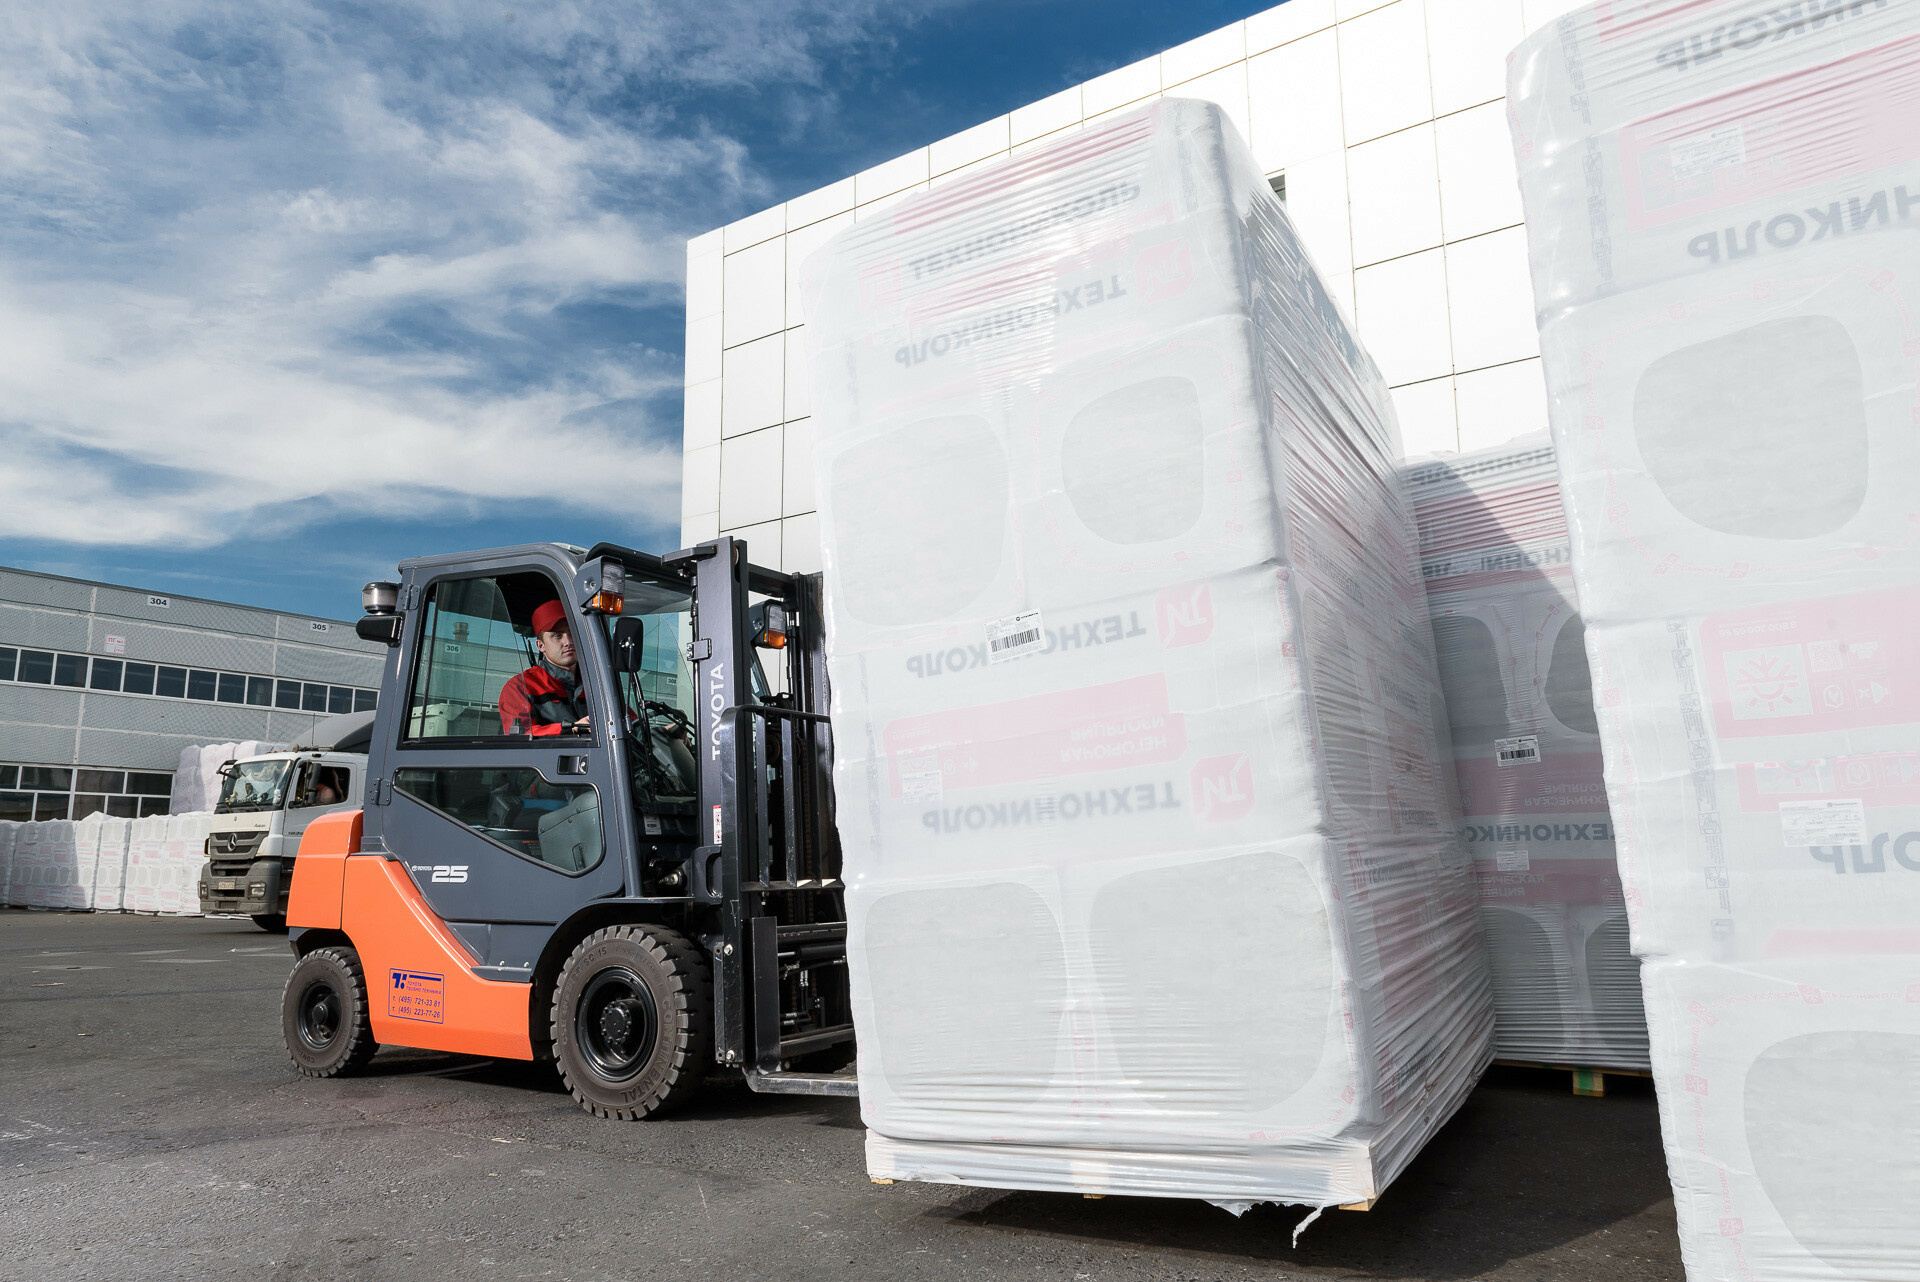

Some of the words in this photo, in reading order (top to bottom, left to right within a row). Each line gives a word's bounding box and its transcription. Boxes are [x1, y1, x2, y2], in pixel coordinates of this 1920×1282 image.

[150, 597, 167, 606] 304
[312, 623, 327, 631] 305
[906, 610, 1147, 679] ТЕХНОКОЛЬ
[711, 662, 725, 761] TOYOTA
[922, 781, 1182, 835] ТЕХНОНИКОЛЬ
[431, 865, 469, 883] 25
[398, 995, 412, 1005] (495)
[398, 1006, 412, 1015] (495)
